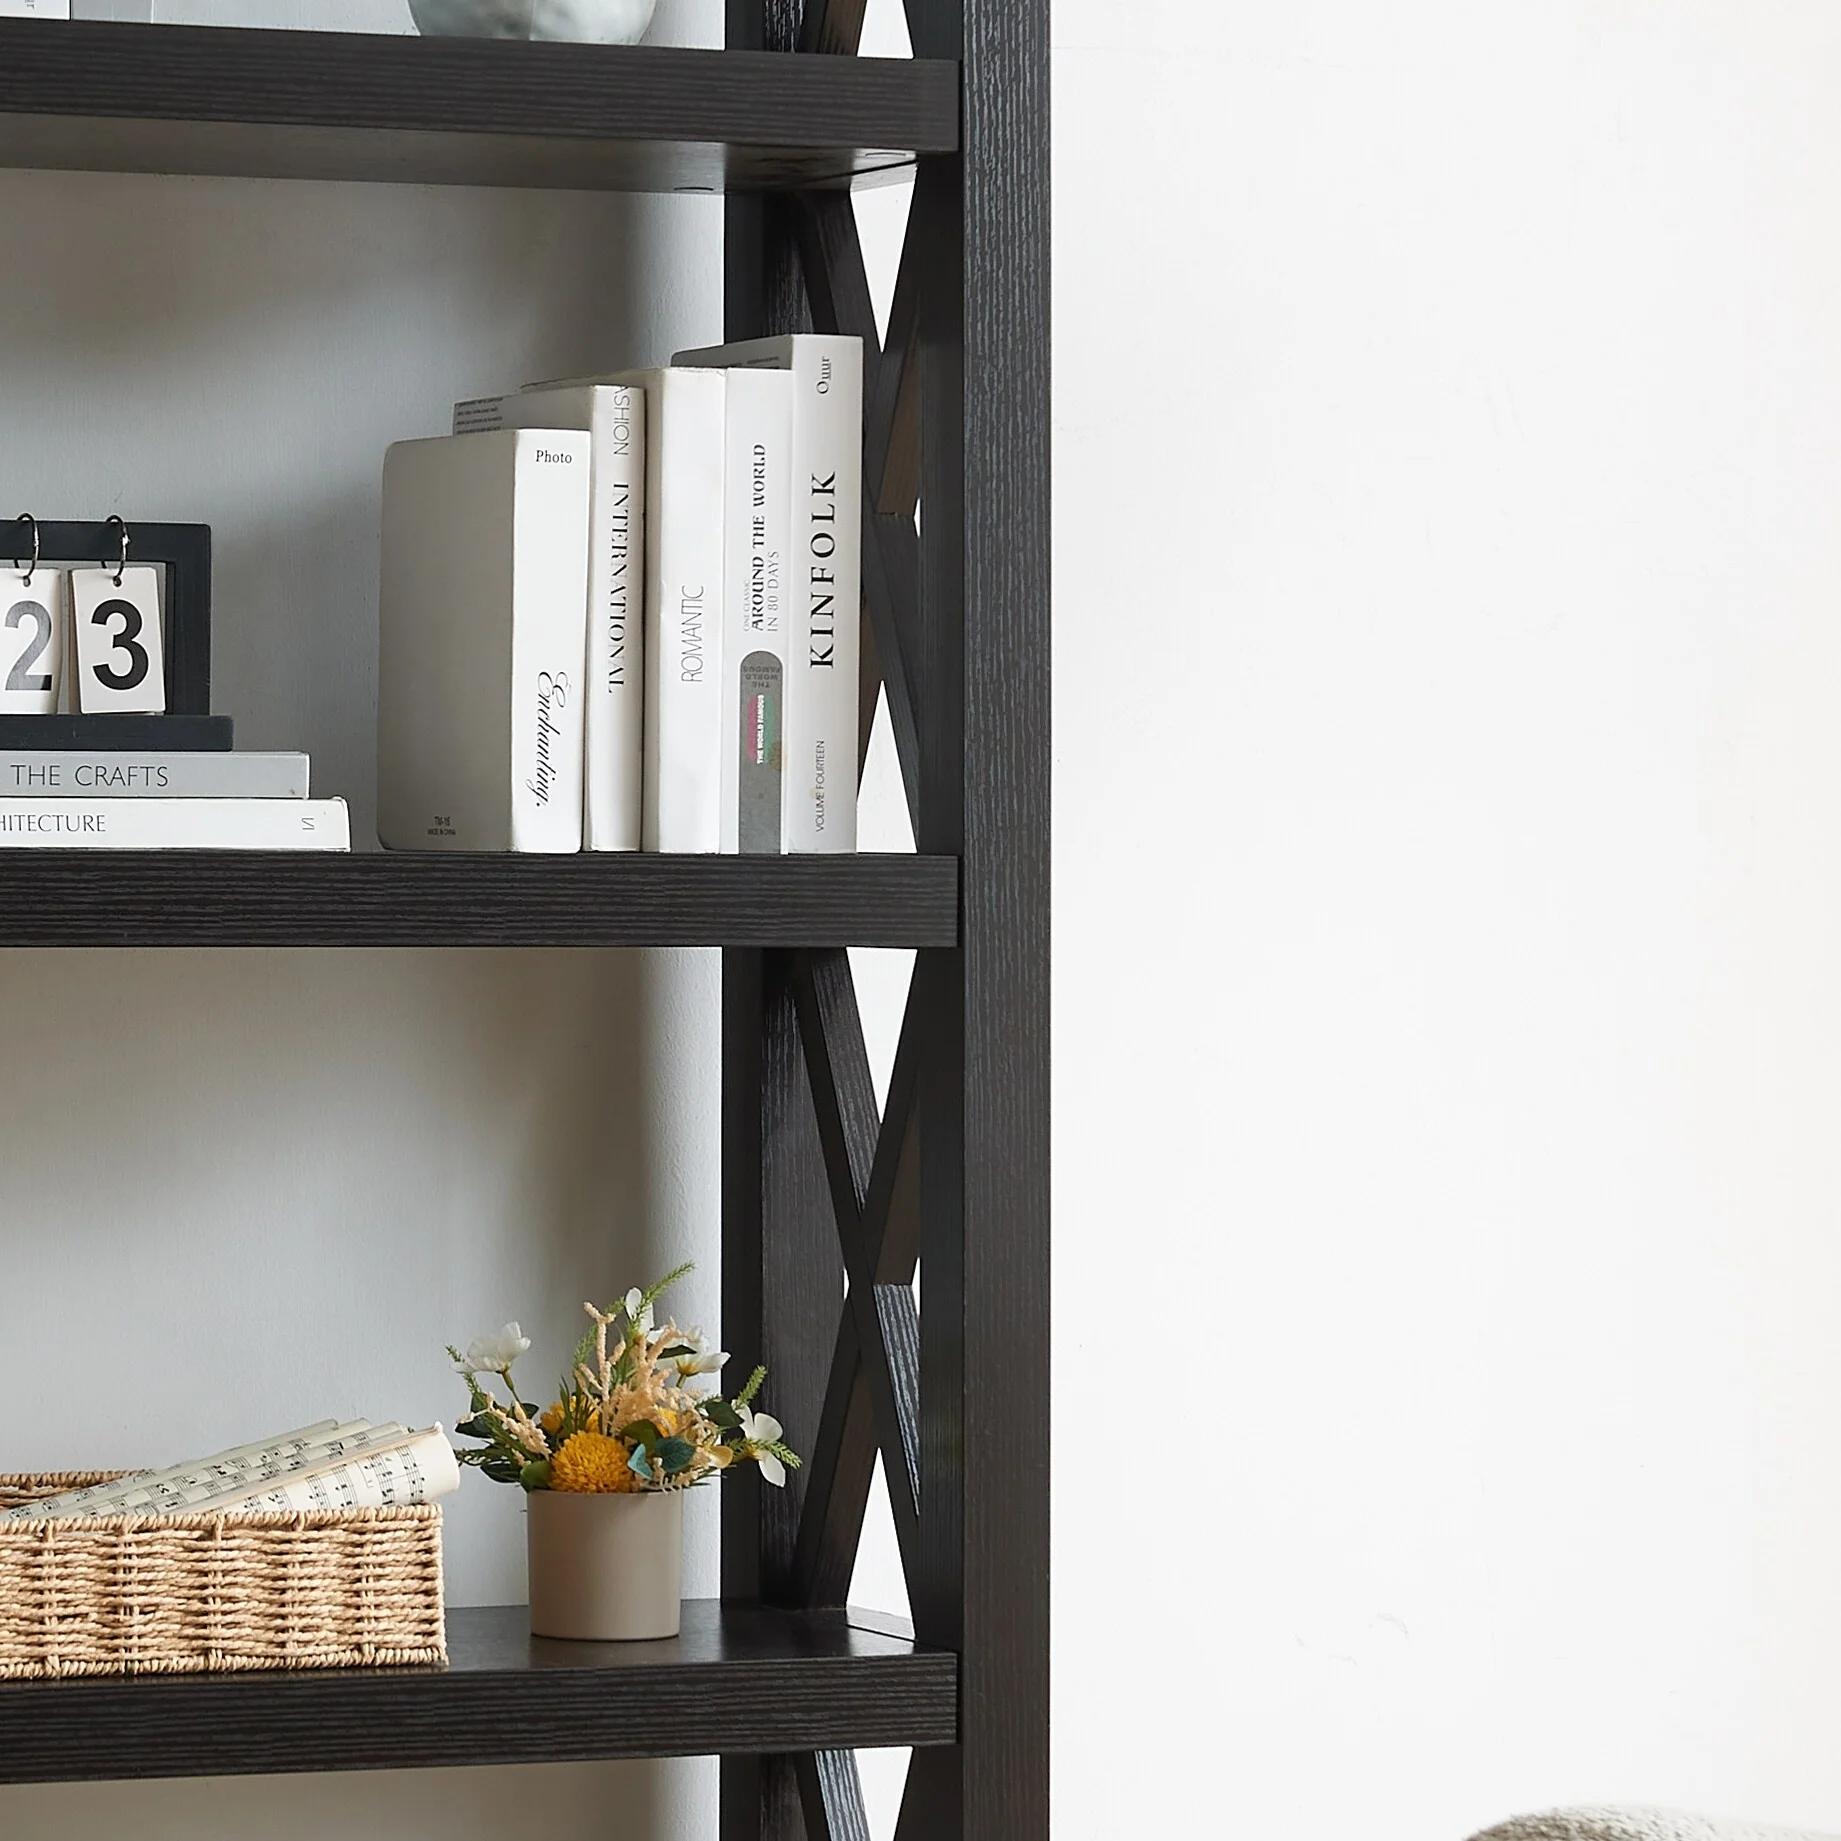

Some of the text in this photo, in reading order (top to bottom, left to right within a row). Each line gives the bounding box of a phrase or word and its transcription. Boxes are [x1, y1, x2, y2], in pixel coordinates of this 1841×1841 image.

[535, 449, 573, 464] Photo
[752, 444, 766, 631] AROUND THE WORLD
[810, 472, 836, 669] KINFOLK
[607, 483, 629, 694] INTERNATIONAL
[681, 585, 705, 683] ROMANTIC
[767, 551, 780, 632] IN 80 DAYS
[10, 764, 169, 787] THE CRAFTS
[525, 671, 571, 807] Enchanting.
[816, 740, 826, 833] VOLUME FOURTEEN
